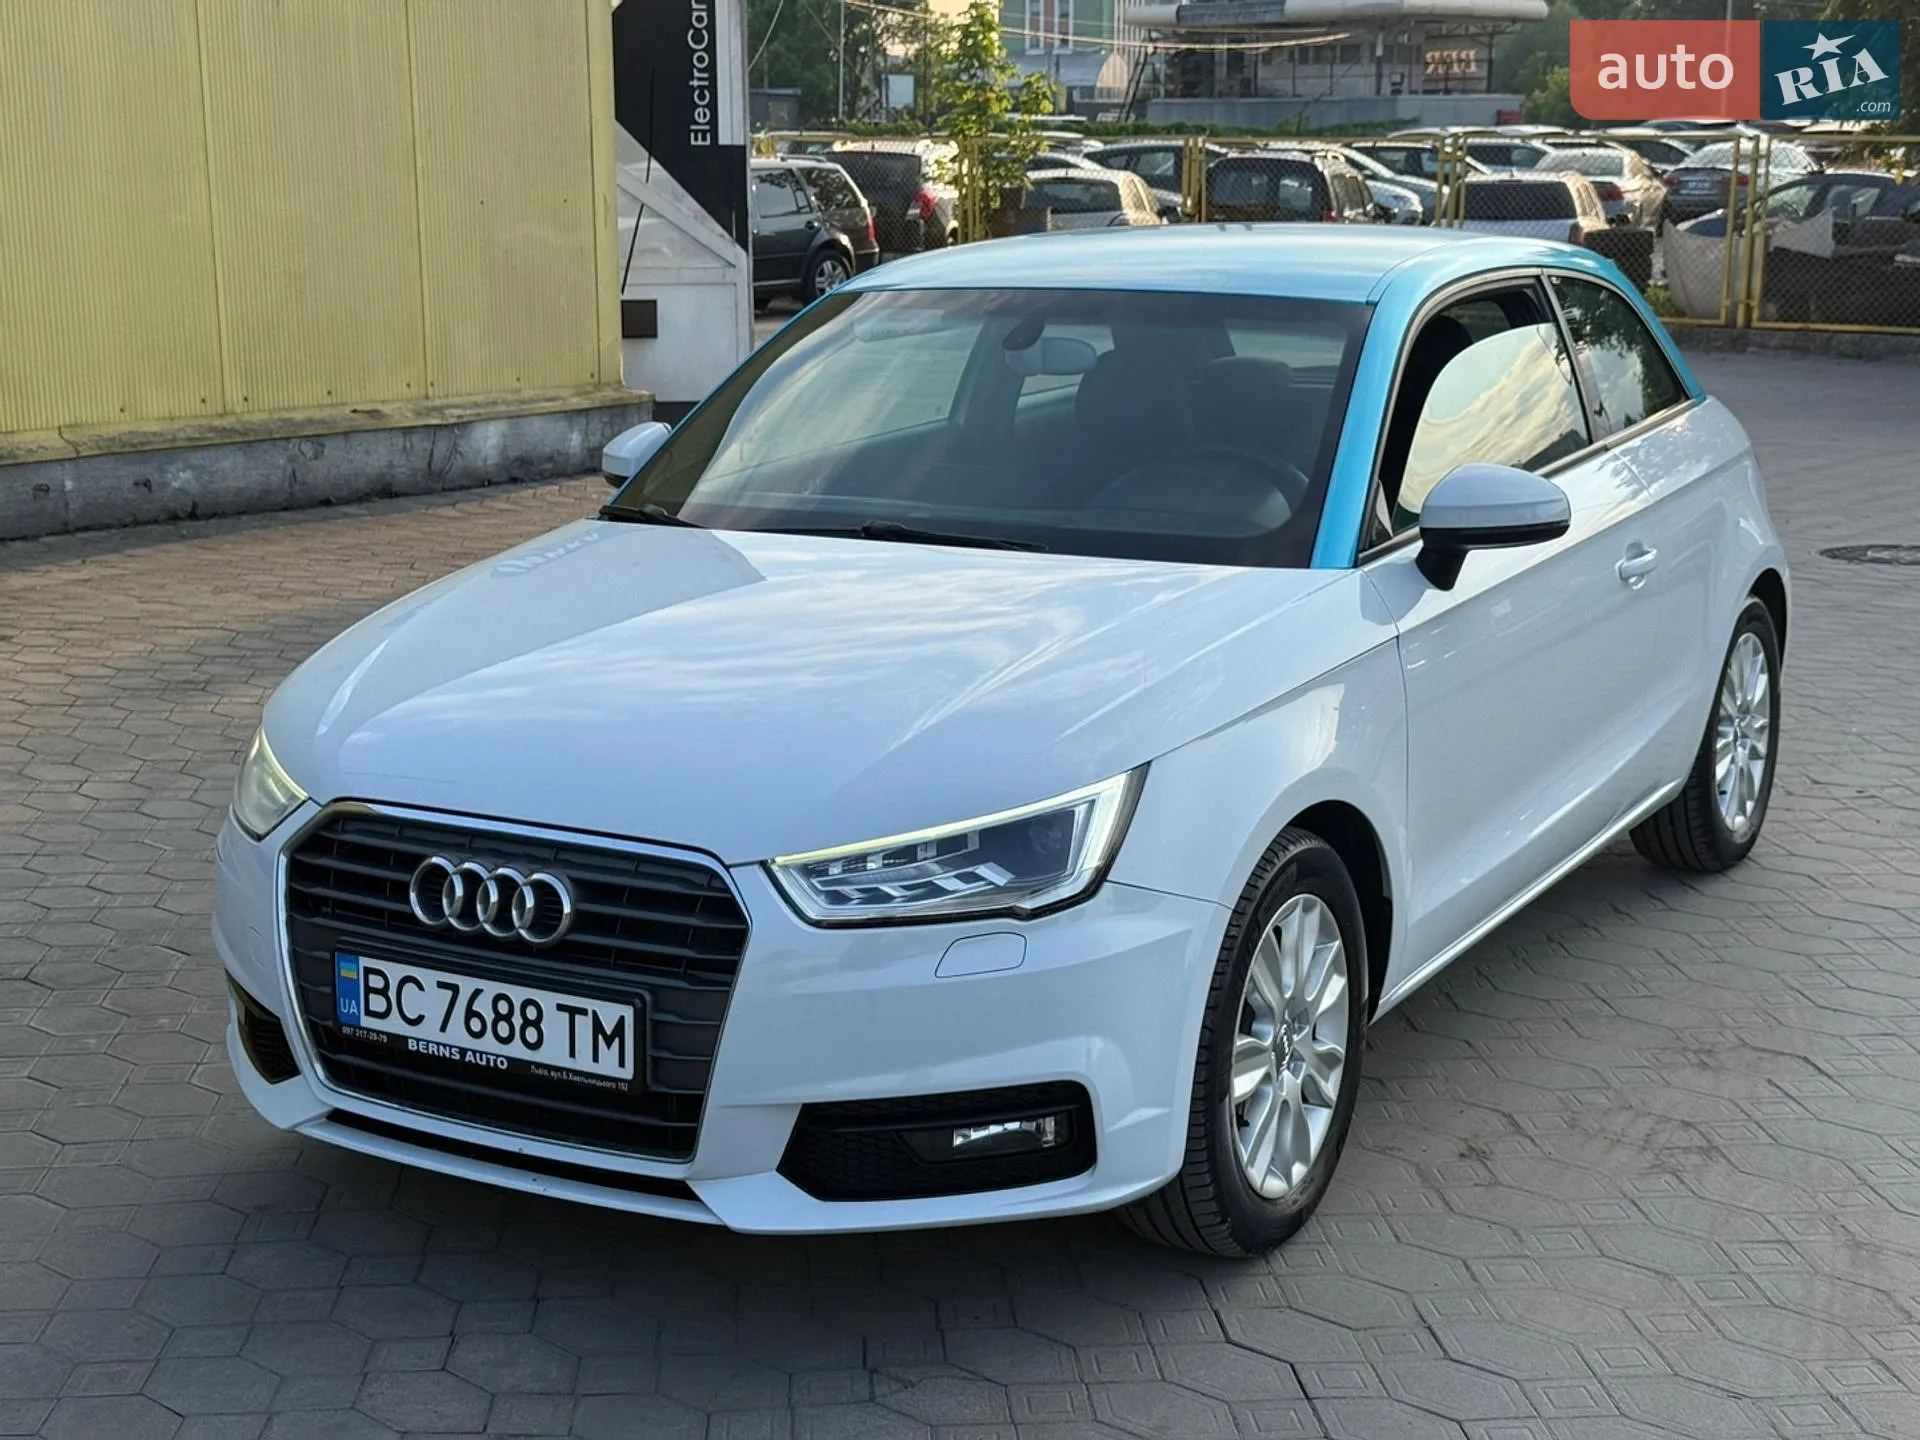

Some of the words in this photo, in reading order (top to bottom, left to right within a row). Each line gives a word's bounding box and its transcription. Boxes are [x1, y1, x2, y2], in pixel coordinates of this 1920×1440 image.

[687, 0, 711, 146] ElectroCar
[340, 997, 359, 1017] UA
[363, 965, 426, 1027] BC
[436, 980, 544, 1051] 7688
[556, 1003, 626, 1069] TM
[407, 1038, 461, 1061] BERNS
[465, 1050, 508, 1070] AUTO
